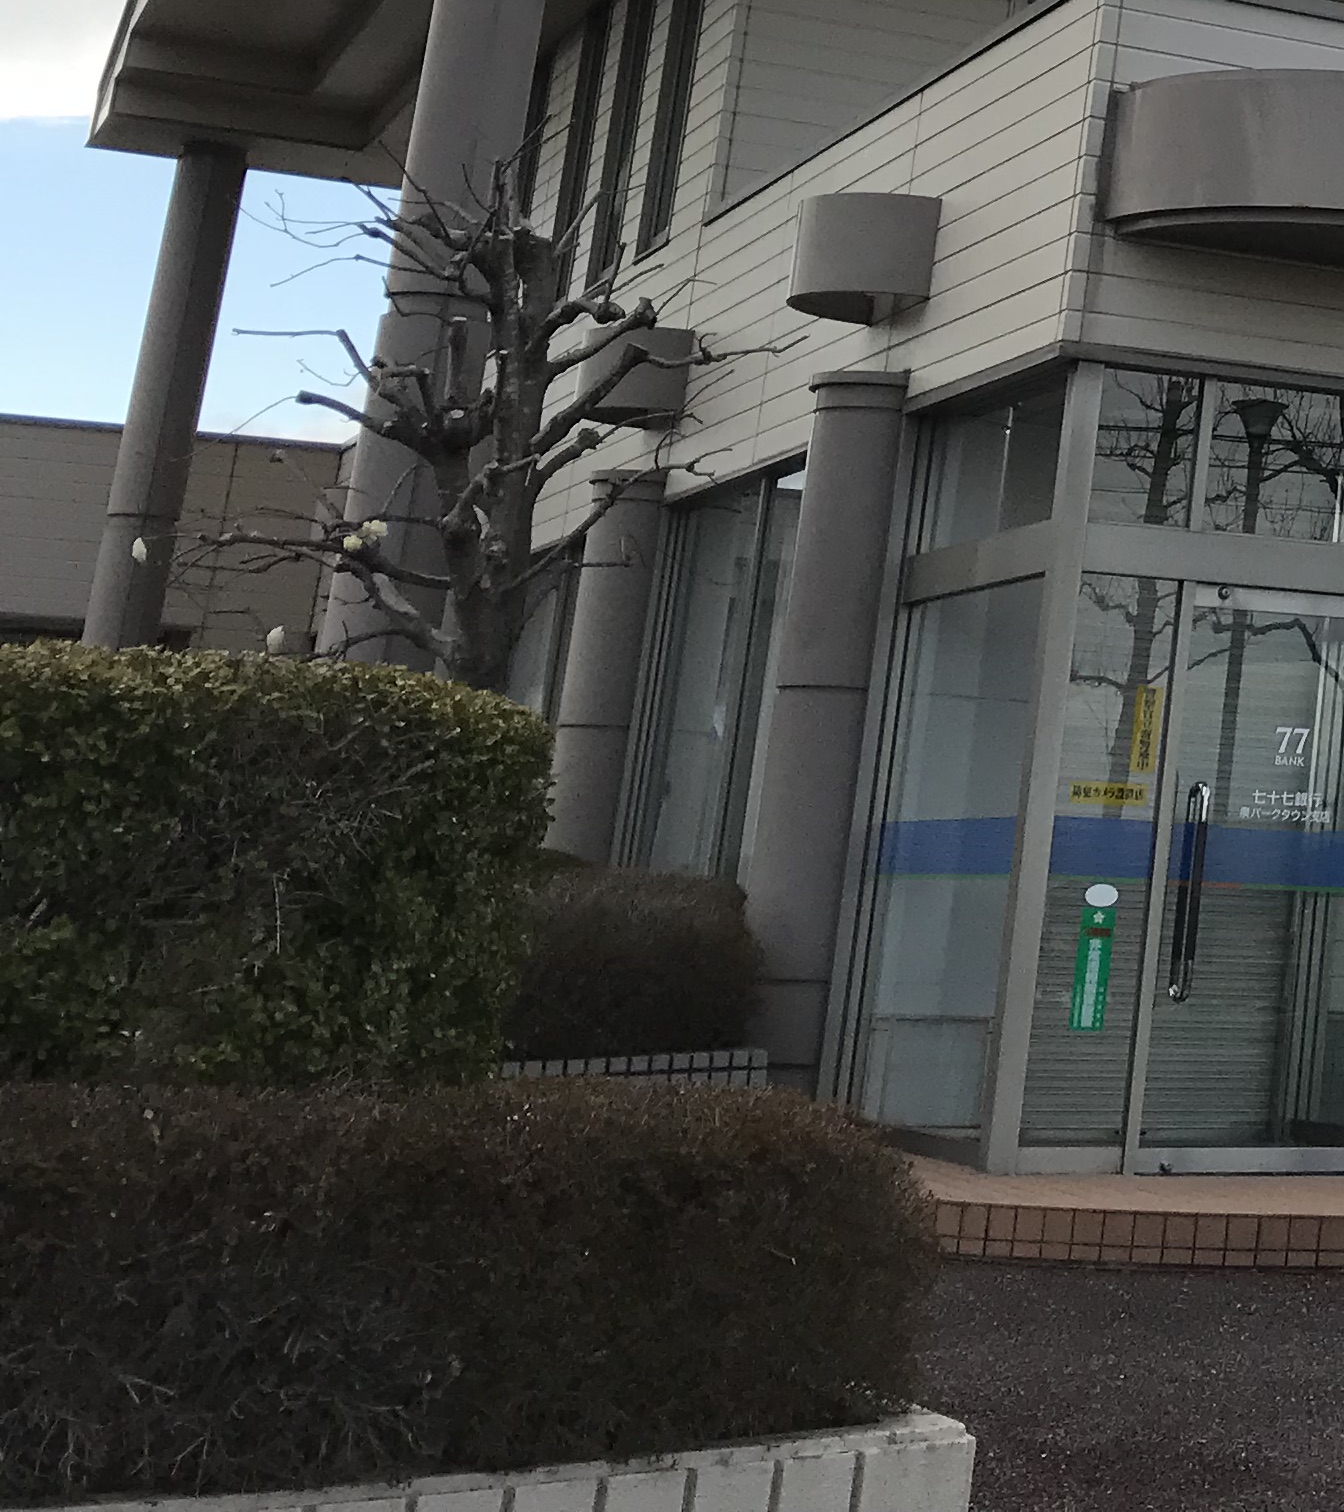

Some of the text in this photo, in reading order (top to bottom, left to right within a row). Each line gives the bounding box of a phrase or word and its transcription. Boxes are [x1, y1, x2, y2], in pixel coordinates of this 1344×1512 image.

[1276, 727, 1310, 754] 77
[1275, 755, 1304, 767] BANK
[1252, 789, 1322, 807] 七十七銀行
